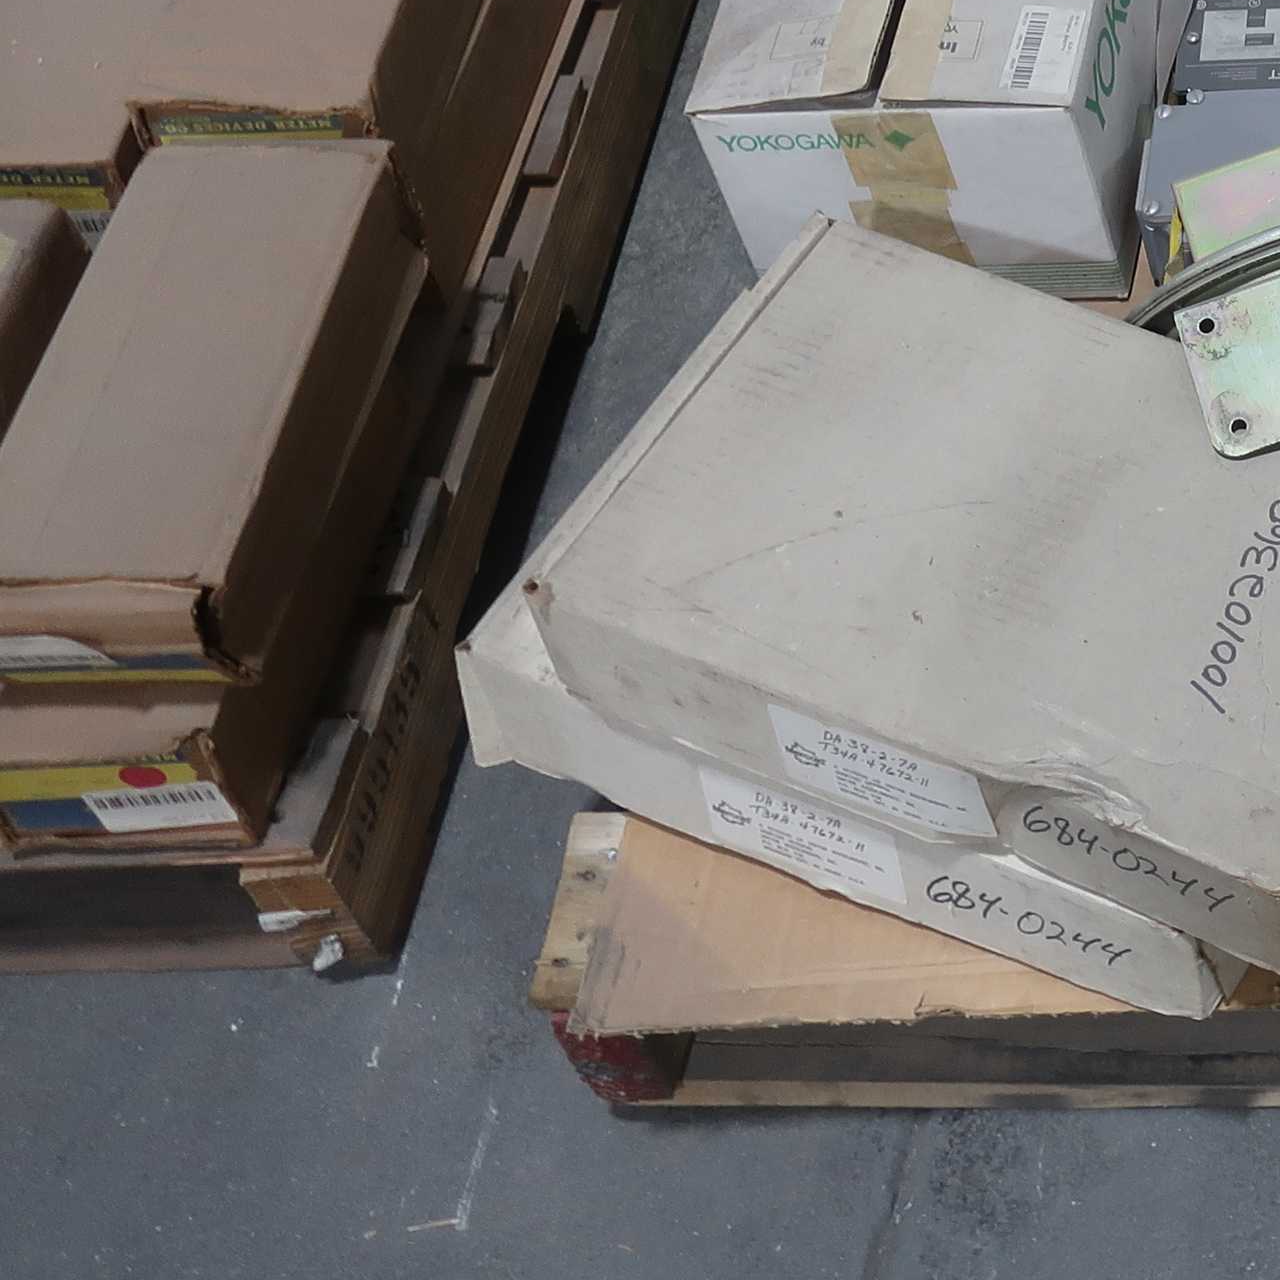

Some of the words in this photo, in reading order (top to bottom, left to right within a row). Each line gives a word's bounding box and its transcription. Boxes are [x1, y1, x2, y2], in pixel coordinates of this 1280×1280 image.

[717, 132, 876, 153] YOKOGAWA
[1023, 806, 1235, 912] 684-0244
[926, 875, 1132, 966] 684-0244
